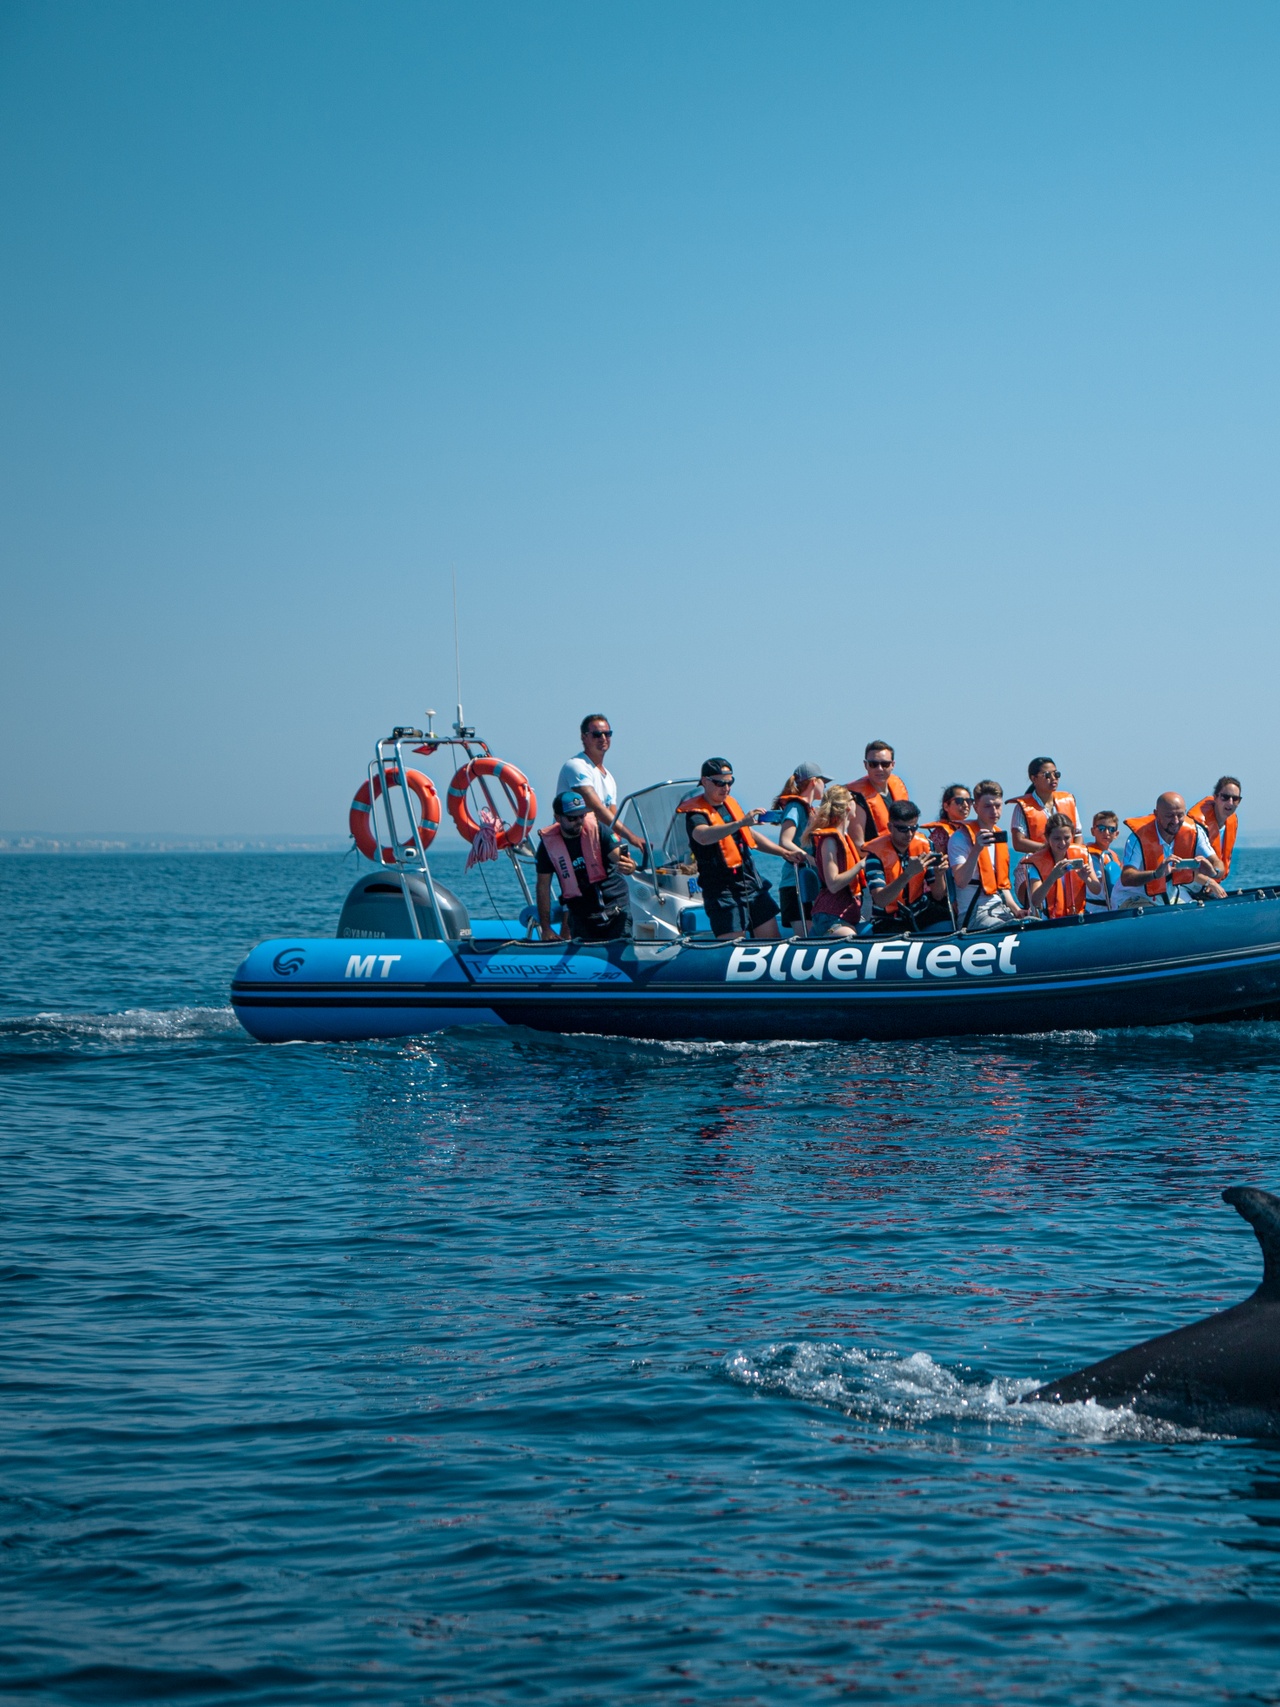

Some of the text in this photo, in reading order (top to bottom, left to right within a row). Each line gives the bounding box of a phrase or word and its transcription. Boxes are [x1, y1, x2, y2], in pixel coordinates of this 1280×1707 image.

[351, 928, 386, 939] YAMAHA
[344, 954, 402, 978] MT
[725, 934, 1020, 982] BlueFleet
[466, 960, 622, 980] Tempest 750
